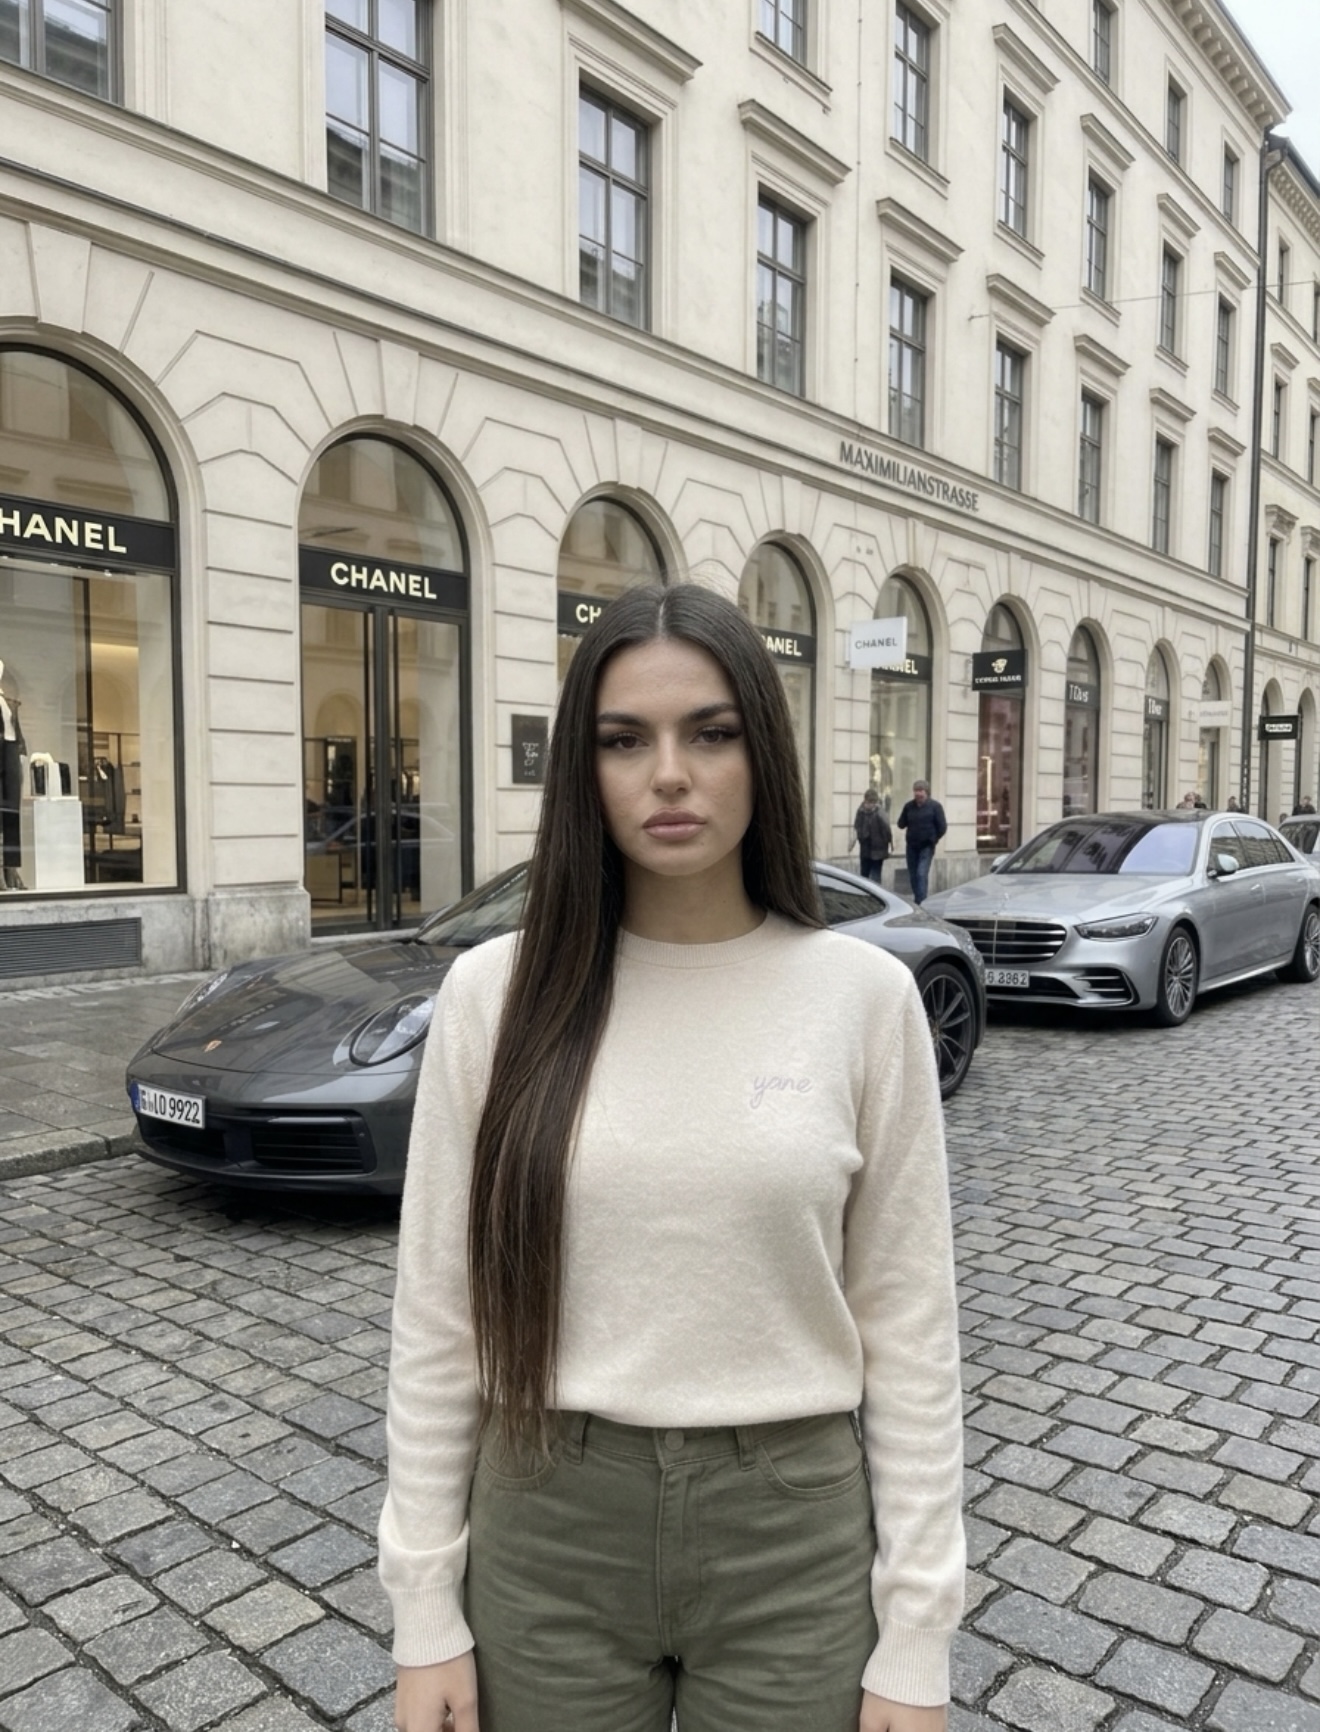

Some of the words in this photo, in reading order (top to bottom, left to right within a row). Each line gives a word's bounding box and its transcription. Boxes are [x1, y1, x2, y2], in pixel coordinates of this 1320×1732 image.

[840, 441, 979, 511] MAXIMILIANSTRASSE
[0, 508, 127, 553] HANEL
[331, 562, 437, 599] CHANEL
[762, 635, 802, 656] ANEL
[855, 637, 897, 649] CHANEL
[169, 1097, 200, 1124] 9922
